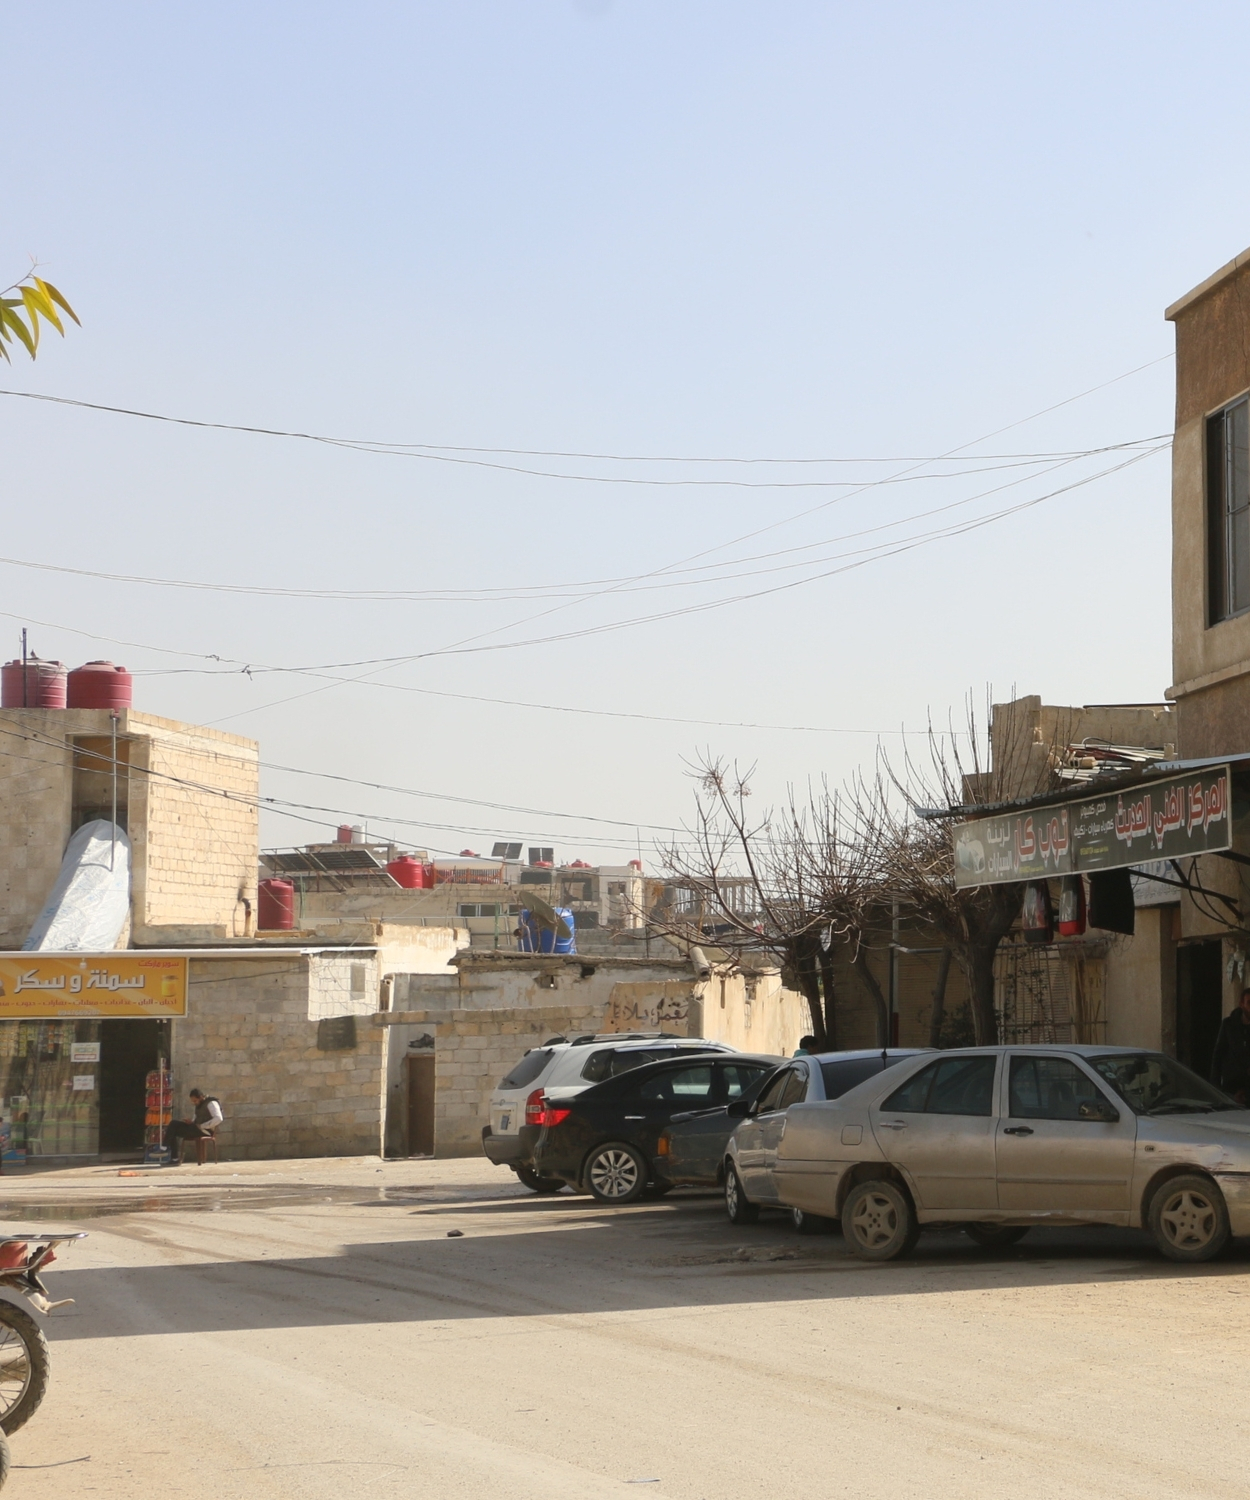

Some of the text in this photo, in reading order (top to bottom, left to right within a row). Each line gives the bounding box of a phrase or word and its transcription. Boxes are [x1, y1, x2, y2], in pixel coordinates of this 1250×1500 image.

[1115, 776, 1227, 850] المركز الفني الحديث
[986, 821, 1011, 847] لزينة
[1013, 809, 1069, 874] توب كار
[1087, 822, 1101, 836] سيارات
[987, 850, 1012, 877] السيارات
[138, 959, 161, 968] ماركت
[14, 968, 145, 994] سمنة و سكر
